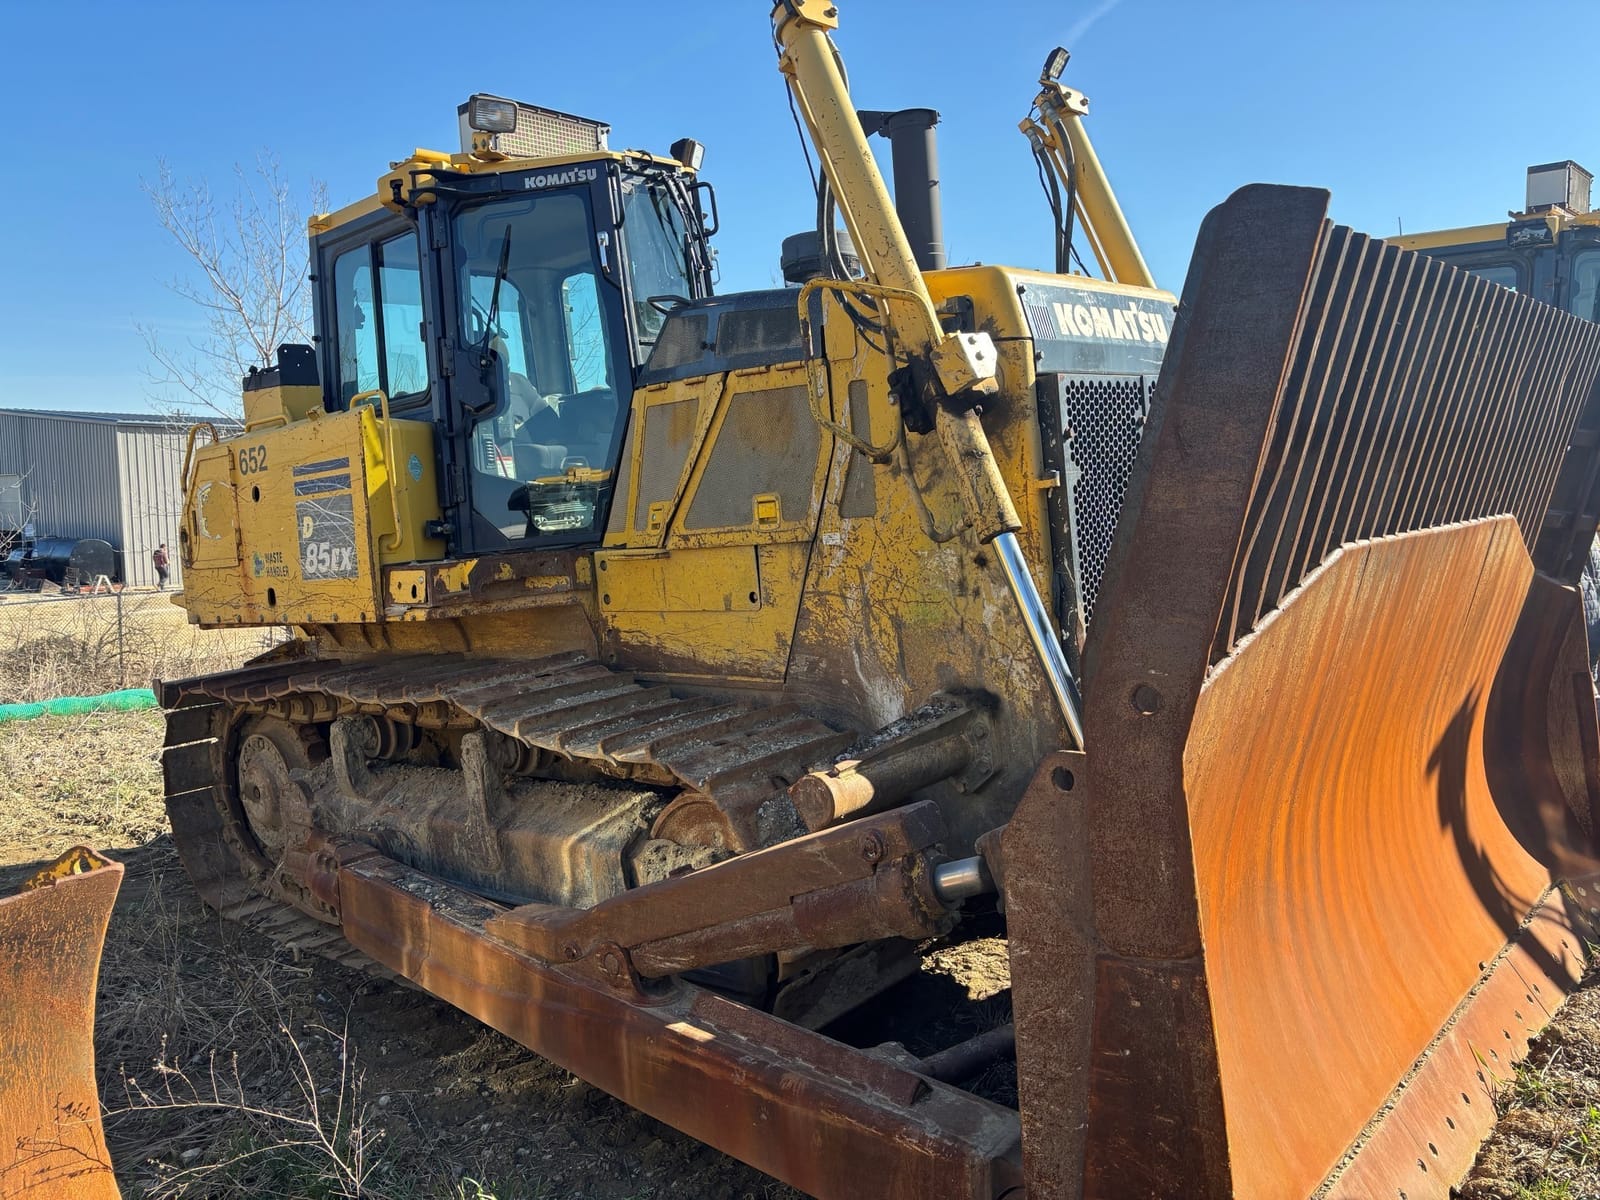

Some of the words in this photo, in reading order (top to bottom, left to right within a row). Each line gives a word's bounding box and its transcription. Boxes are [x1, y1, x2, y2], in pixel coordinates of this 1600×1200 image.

[524, 167, 597, 189] KOMATSU
[1052, 301, 1168, 343] KOMATSU
[239, 444, 268, 476] 652
[302, 515, 314, 539] D
